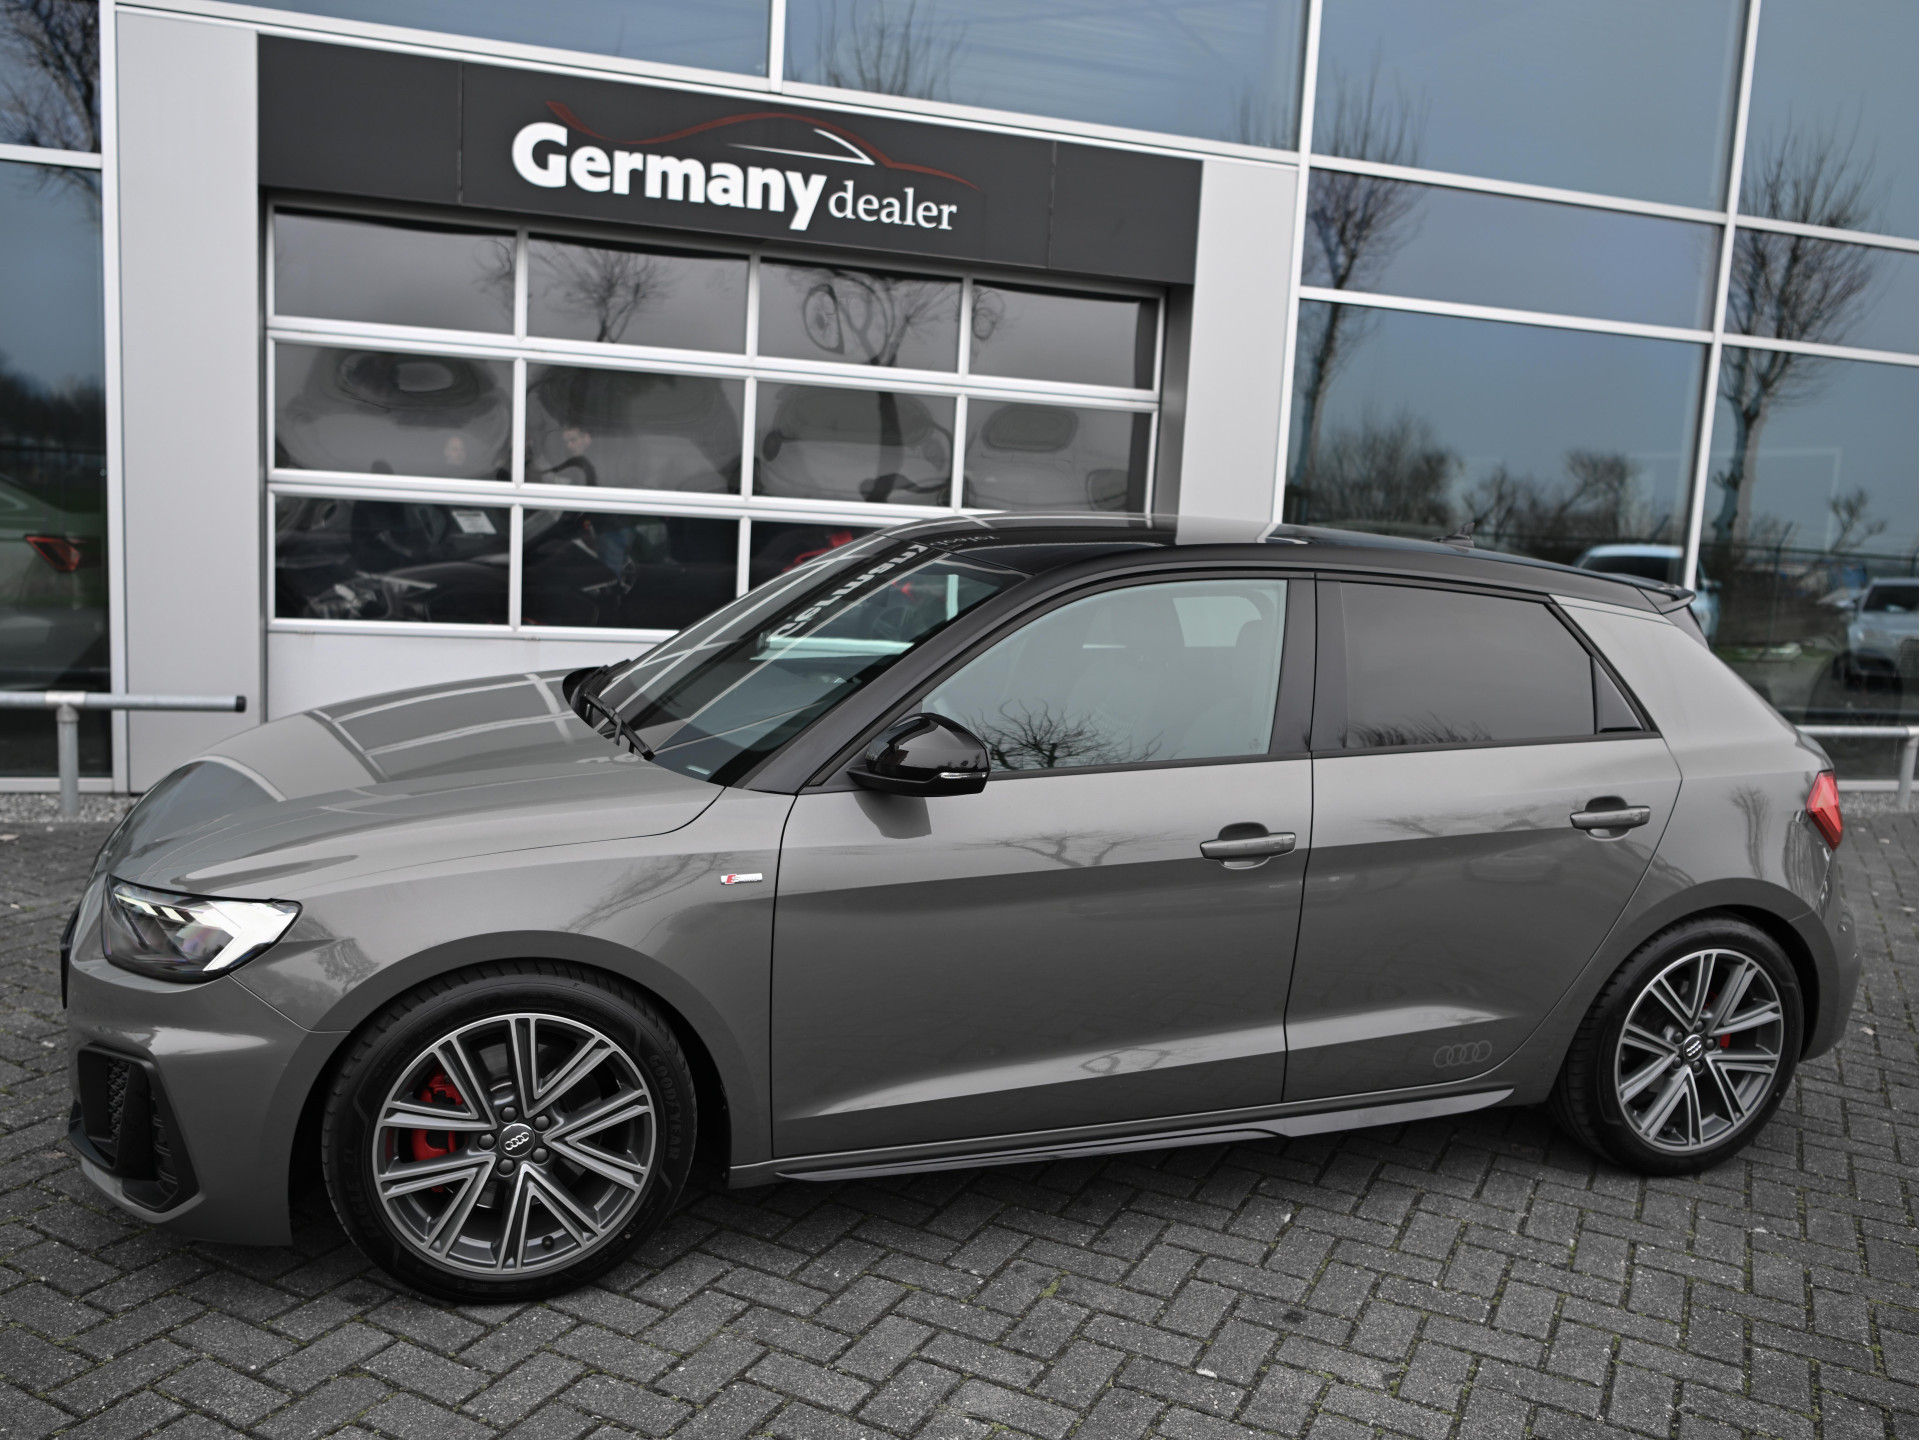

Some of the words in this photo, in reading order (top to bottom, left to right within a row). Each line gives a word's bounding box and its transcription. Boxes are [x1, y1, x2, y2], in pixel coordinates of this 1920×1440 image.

[511, 122, 827, 230] Germany
[828, 180, 957, 230] dealer
[648, 1054, 681, 1160] GOODYEAR
